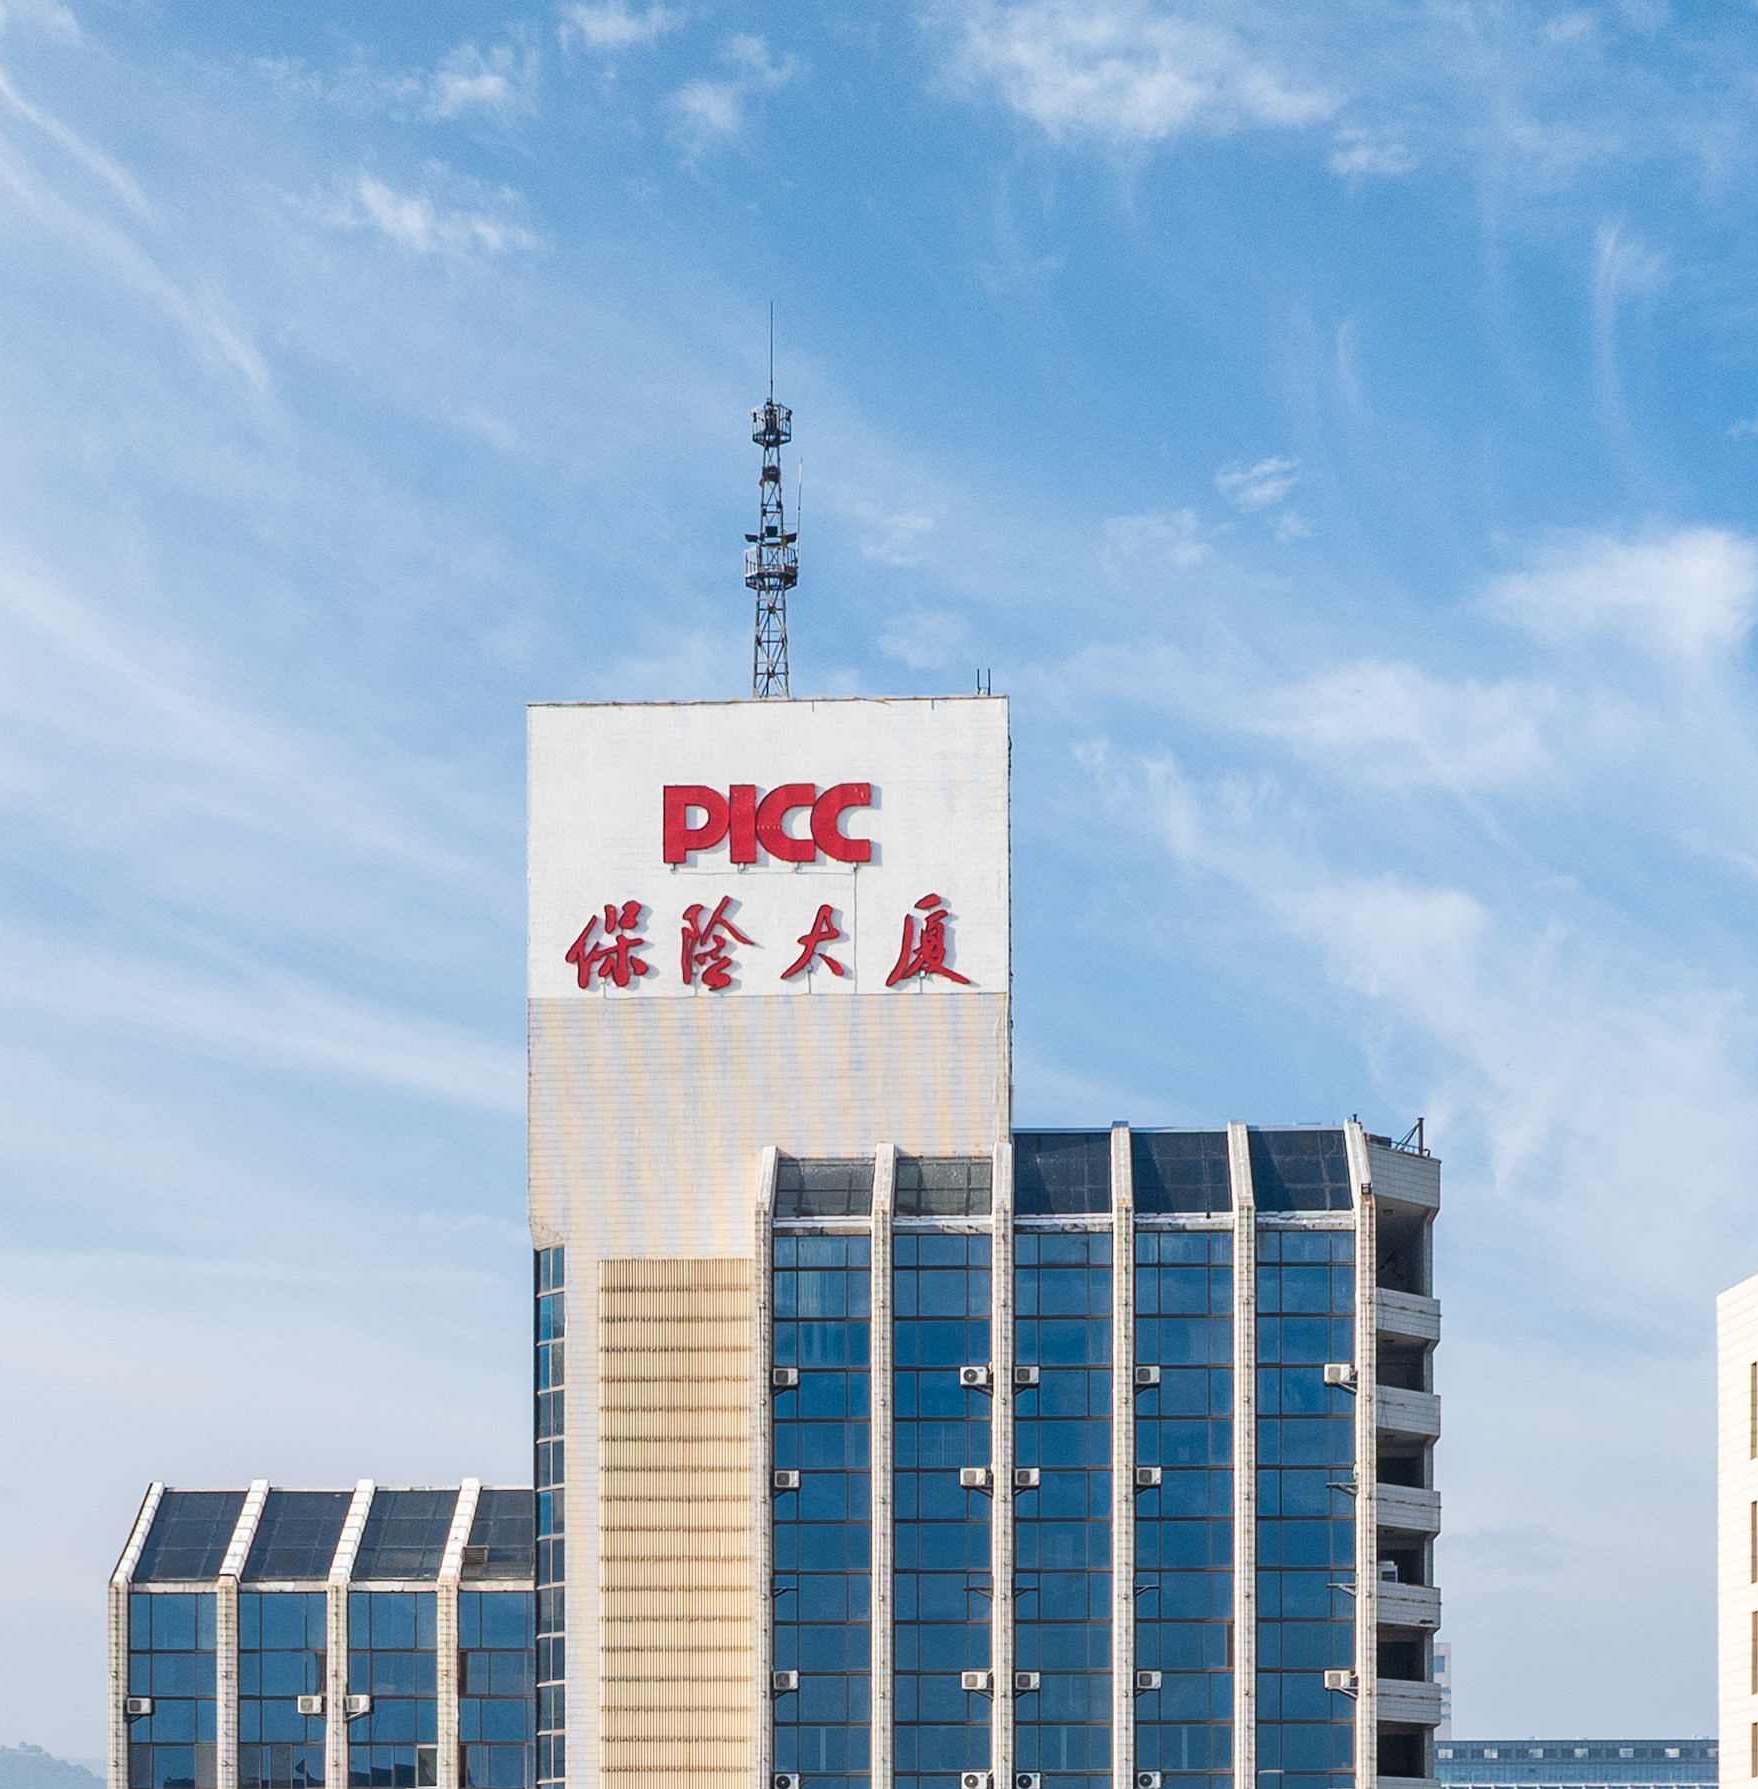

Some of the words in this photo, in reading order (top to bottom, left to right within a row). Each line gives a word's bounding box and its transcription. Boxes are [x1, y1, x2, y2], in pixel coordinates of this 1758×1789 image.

[663, 783, 871, 864] PICC
[565, 893, 971, 990] 保险大厦
